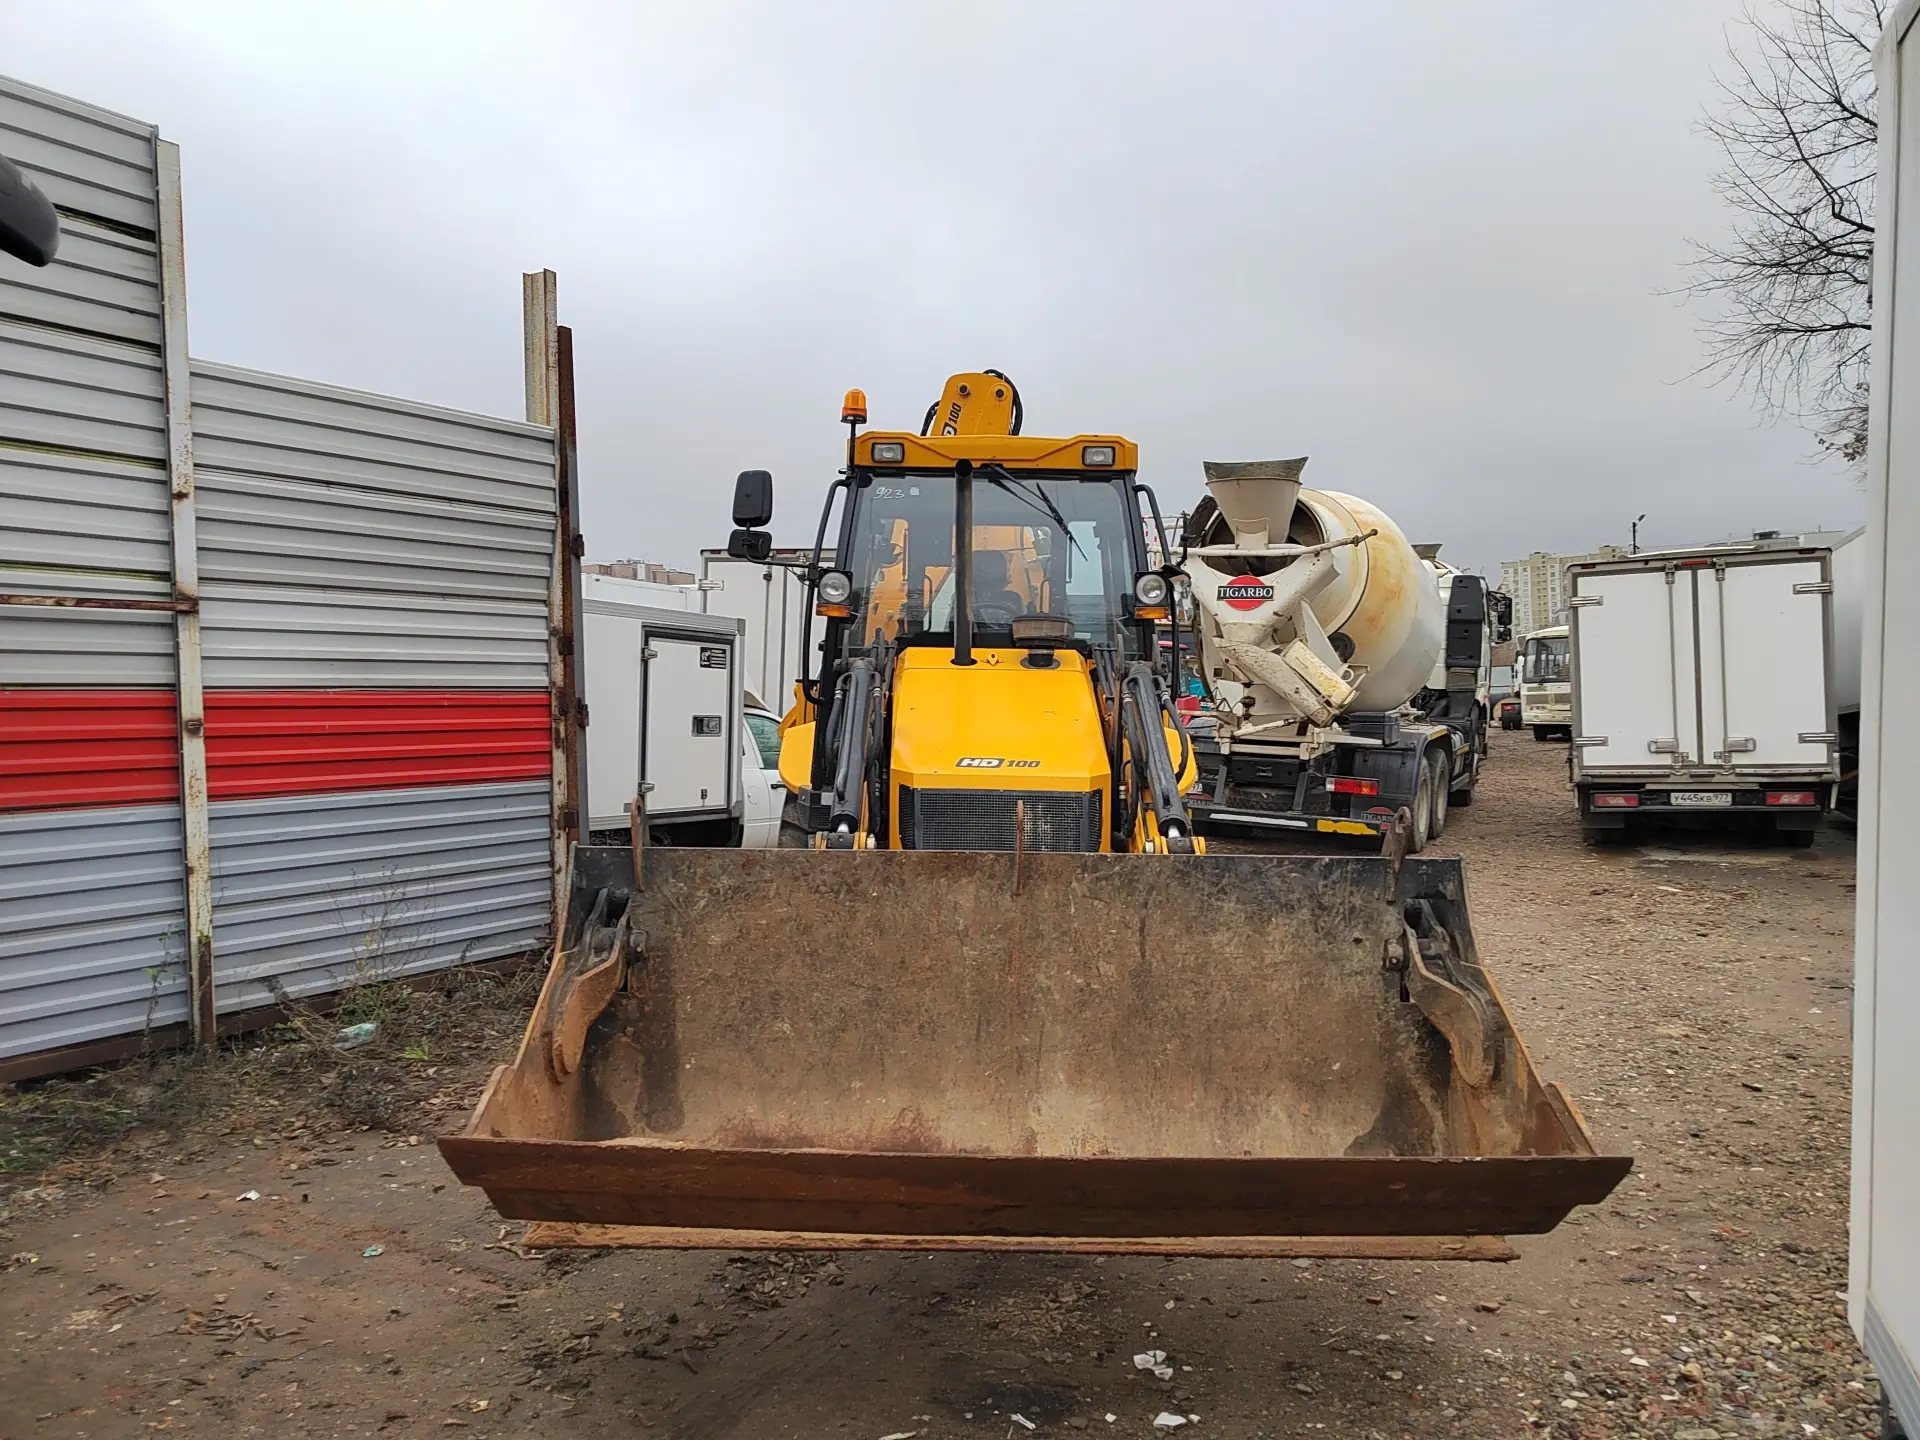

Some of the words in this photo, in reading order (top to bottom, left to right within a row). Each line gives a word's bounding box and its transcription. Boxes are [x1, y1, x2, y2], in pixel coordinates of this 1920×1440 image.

[948, 402, 962, 424] 100
[873, 486, 905, 499] 923
[1218, 587, 1273, 598] TIGARBO
[957, 757, 1002, 768] HD
[1006, 760, 1041, 768] 100
[1363, 813, 1395, 822] TIGARB
